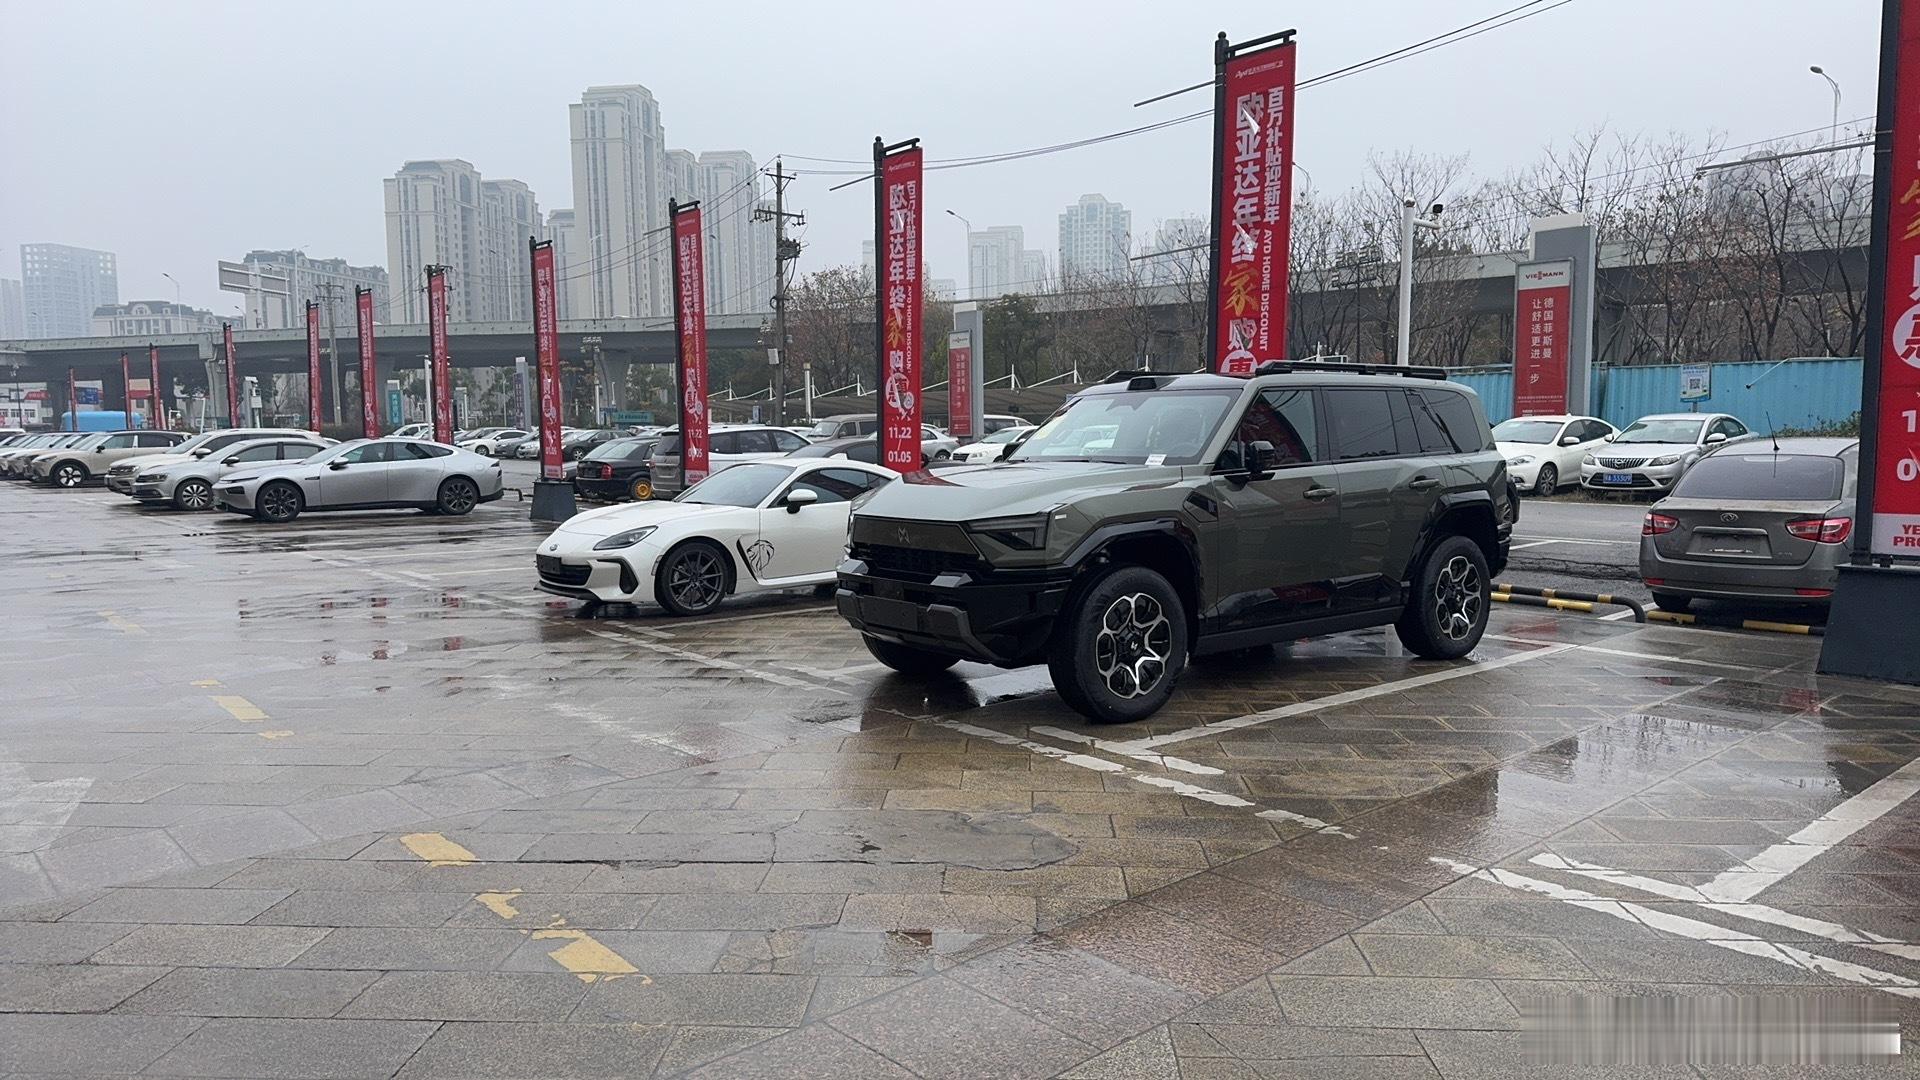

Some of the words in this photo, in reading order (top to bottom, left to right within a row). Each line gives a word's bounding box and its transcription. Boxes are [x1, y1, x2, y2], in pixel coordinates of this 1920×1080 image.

[1264, 86, 1284, 224] 百万补贴迎新年
[1264, 229, 1272, 253] AYD
[1262, 255, 1272, 291] HOME
[1260, 295, 1270, 351] DISCOUNT
[1529, 298, 1542, 384] 让舒适更进一步
[1542, 297, 1554, 359] 德国菲斯曼
[889, 427, 912, 439] 11.22
[888, 451, 912, 463] 01.05
